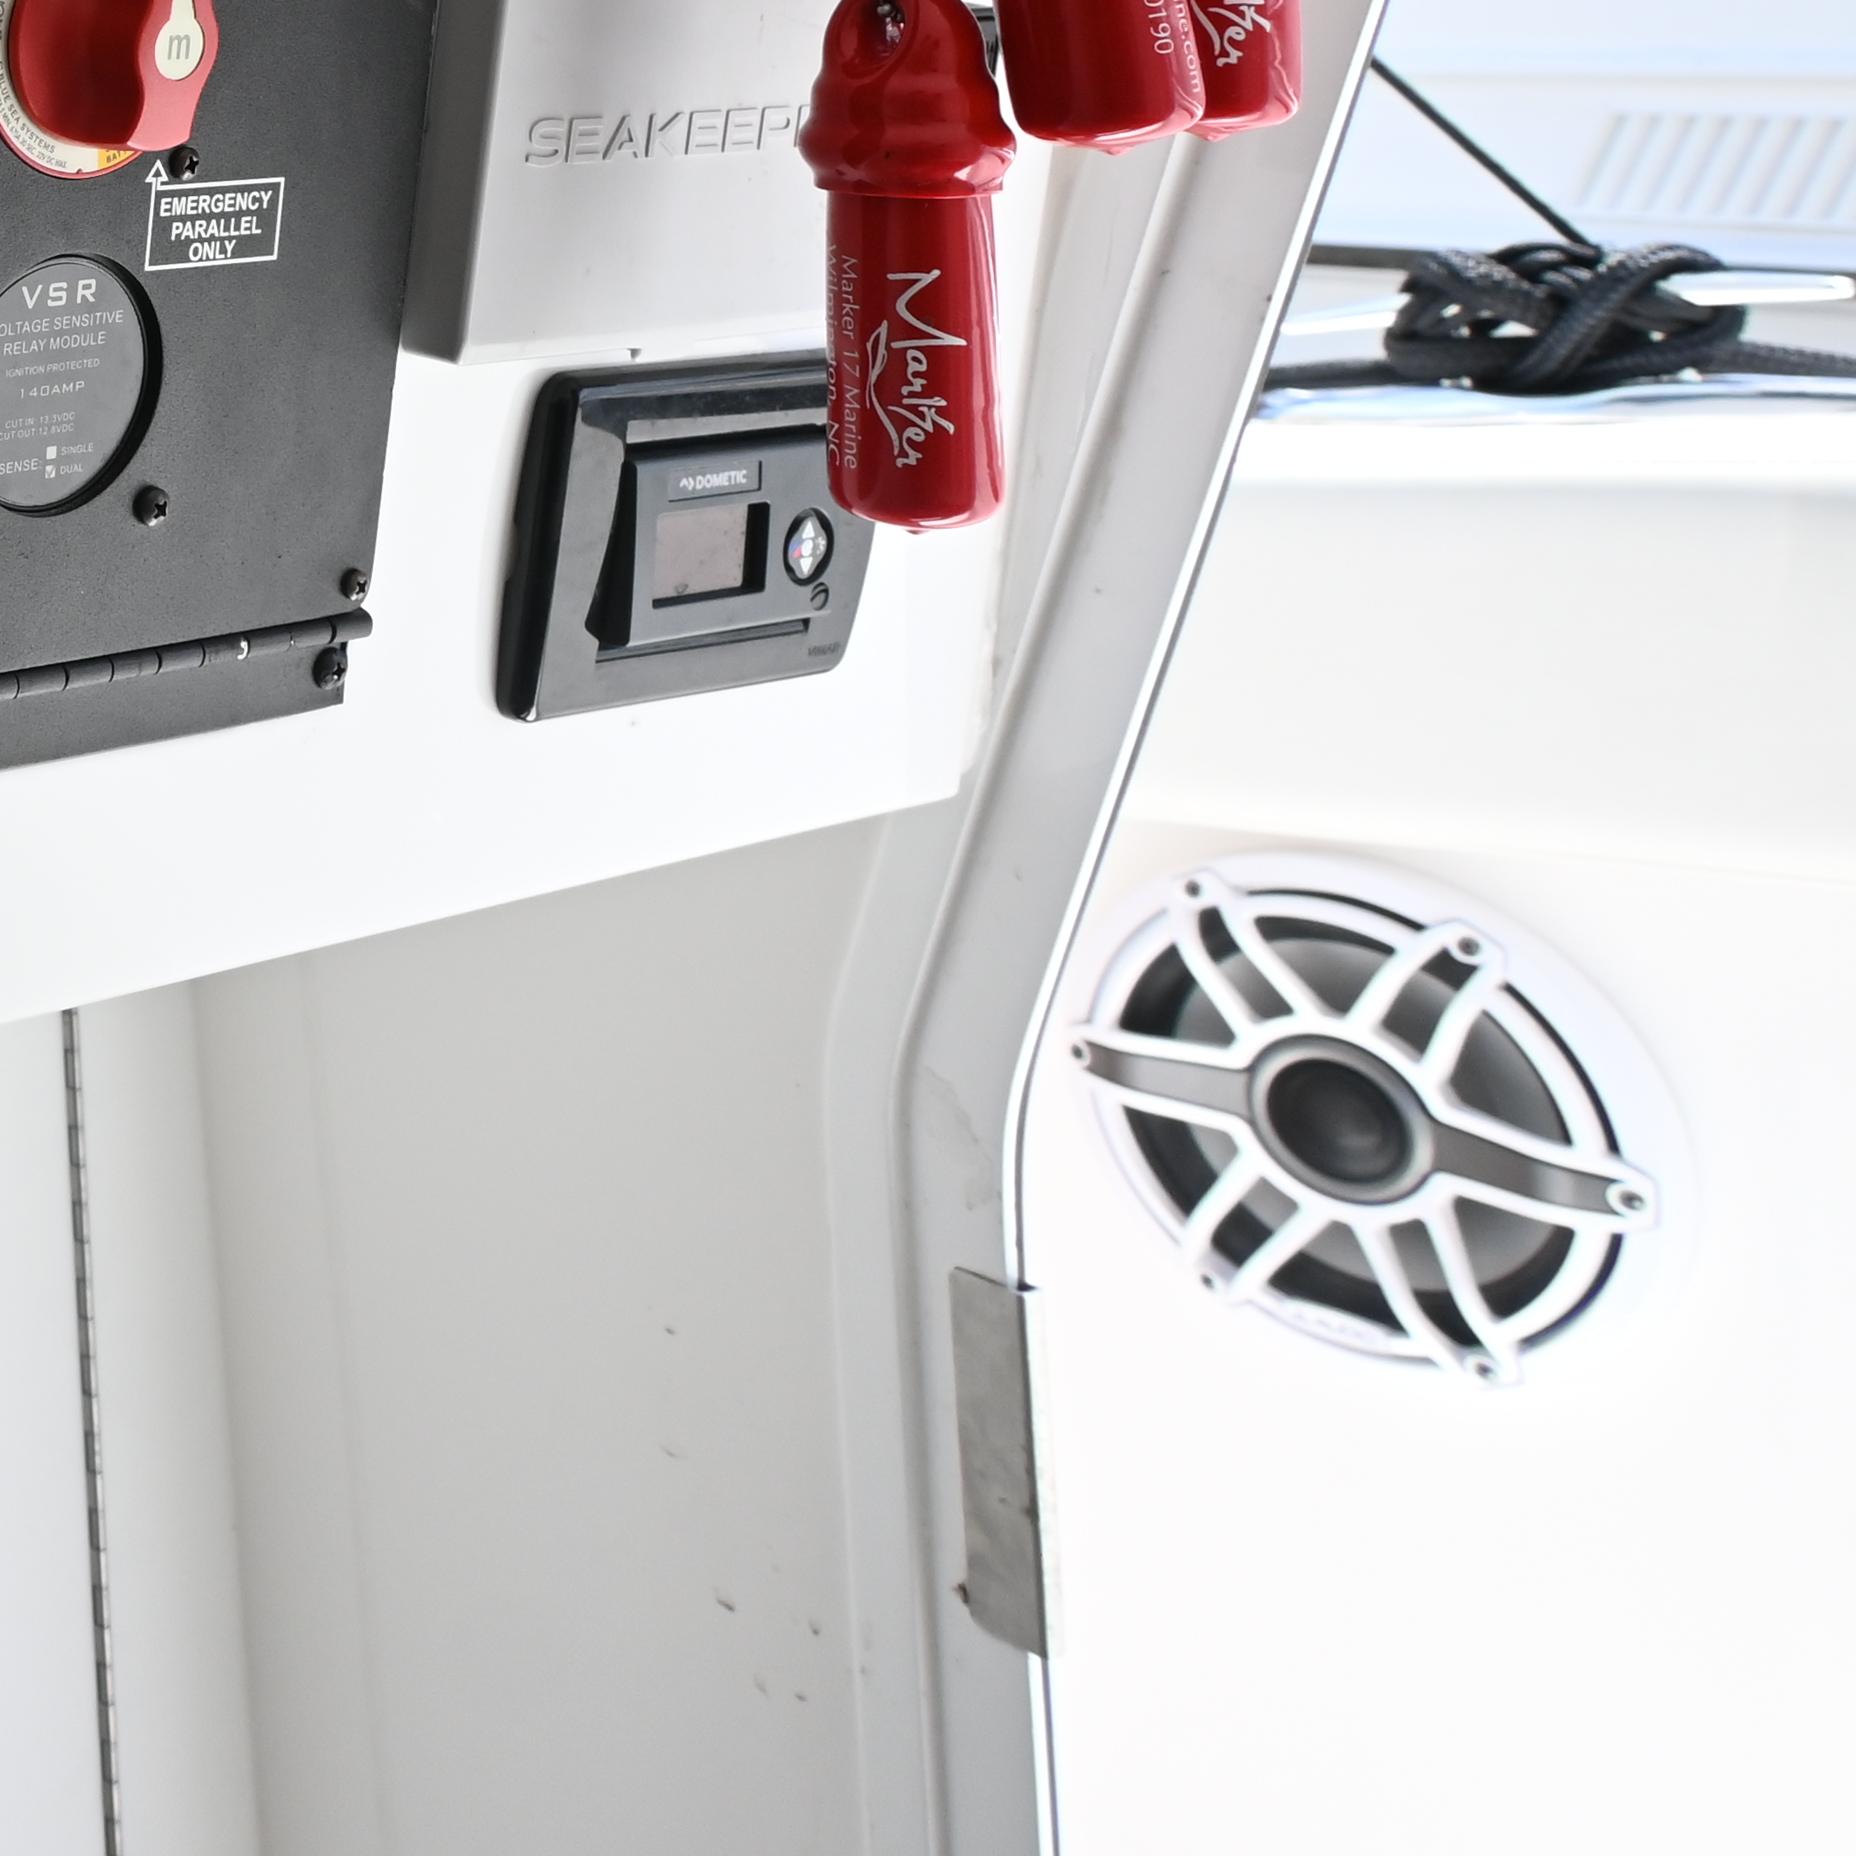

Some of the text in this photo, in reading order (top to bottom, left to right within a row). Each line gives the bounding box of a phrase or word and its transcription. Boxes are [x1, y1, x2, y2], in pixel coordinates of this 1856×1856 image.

[524, 104, 810, 168] SEAKEEP
[159, 189, 273, 218] EMERGENCY
[170, 216, 263, 242] PARALLEL
[188, 240, 237, 263] ONLY
[22, 279, 97, 309] VSR
[841, 255, 862, 470] Marker 17 Marine
[695, 470, 747, 490] DOMETIC
